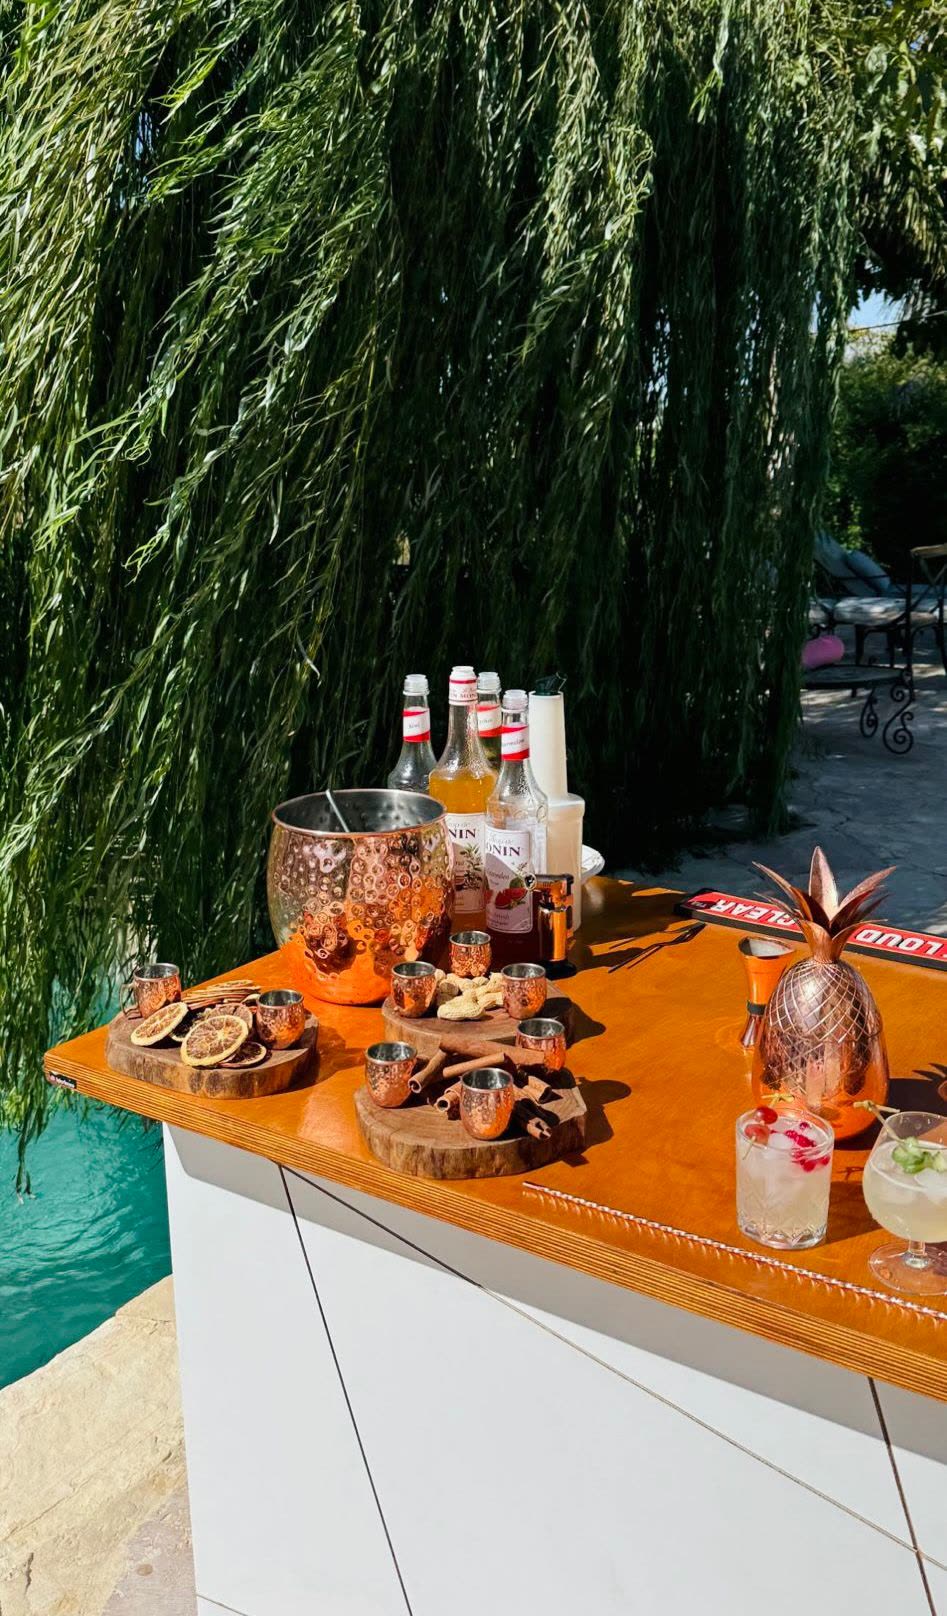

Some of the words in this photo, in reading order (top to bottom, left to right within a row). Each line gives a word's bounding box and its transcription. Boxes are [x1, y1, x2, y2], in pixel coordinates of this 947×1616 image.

[448, 829, 475, 838] NIN
[710, 899, 796, 926] CLEAR
[855, 929, 943, 955] LOUD
